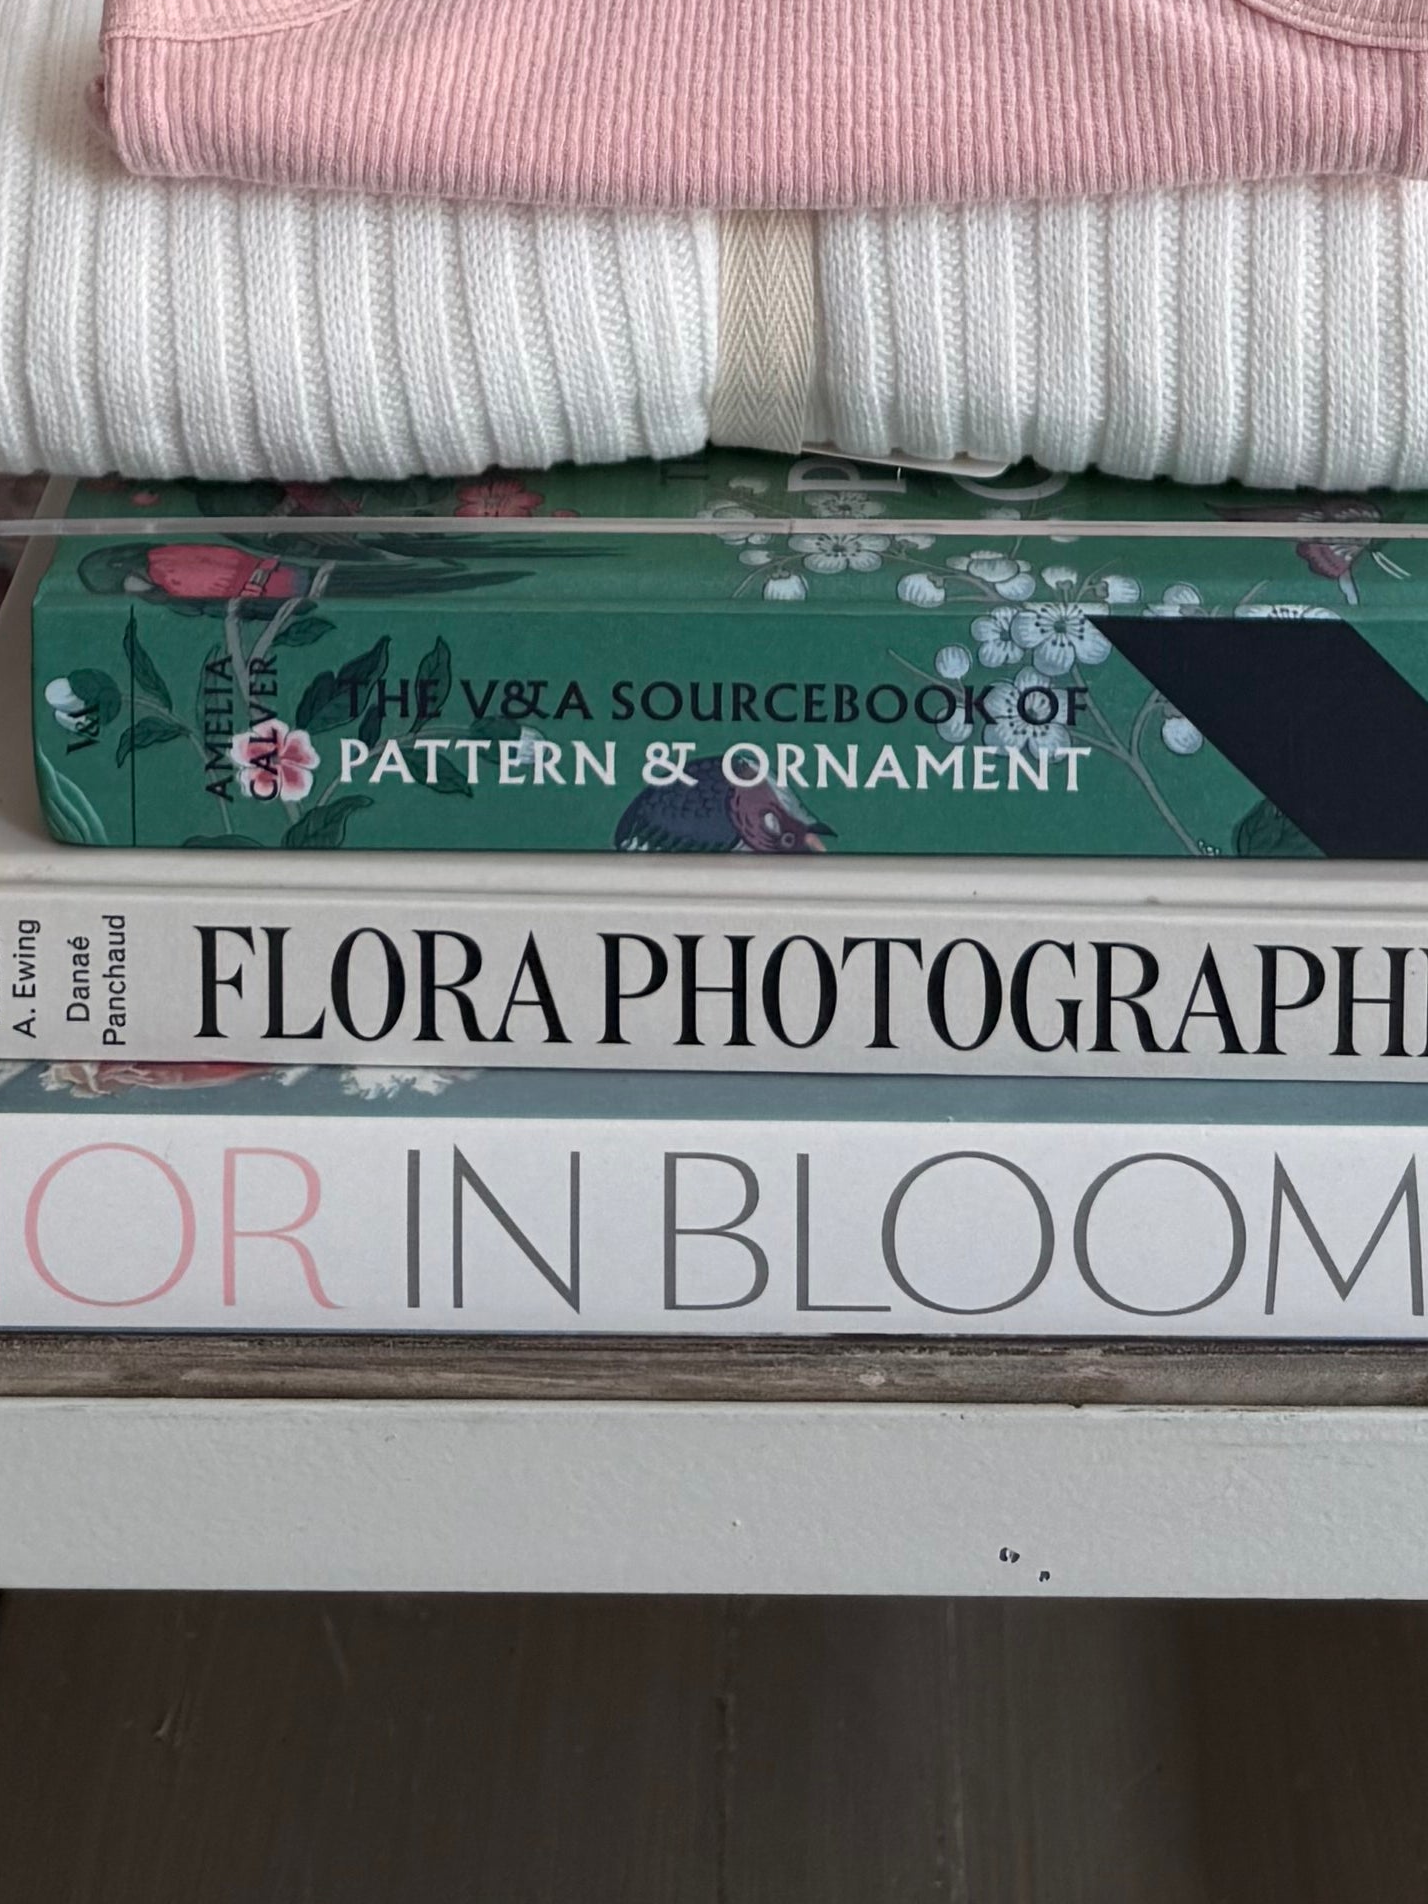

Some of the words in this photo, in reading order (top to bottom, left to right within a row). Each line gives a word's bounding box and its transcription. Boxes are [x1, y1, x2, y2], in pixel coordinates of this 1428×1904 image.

[205, 654, 234, 803] AMELIA
[249, 654, 279, 802] CALVER
[346, 679, 442, 720] THE
[458, 680, 594, 722] V&A
[611, 680, 996, 726] SOURCEBOOK
[1017, 685, 1090, 729] OF
[338, 737, 616, 787] PATTERN
[642, 741, 698, 788] &
[721, 742, 1093, 792] ORNAMENT
[13, 918, 41, 1000] Ewing
[66, 935, 91, 1023] Danaé
[102, 913, 127, 1047] Panchaud
[192, 924, 572, 1046] FLORA
[12, 1006, 37, 1039] A.
[405, 1143, 581, 1314] IN
[662, 1149, 1425, 1318] BLOOM
